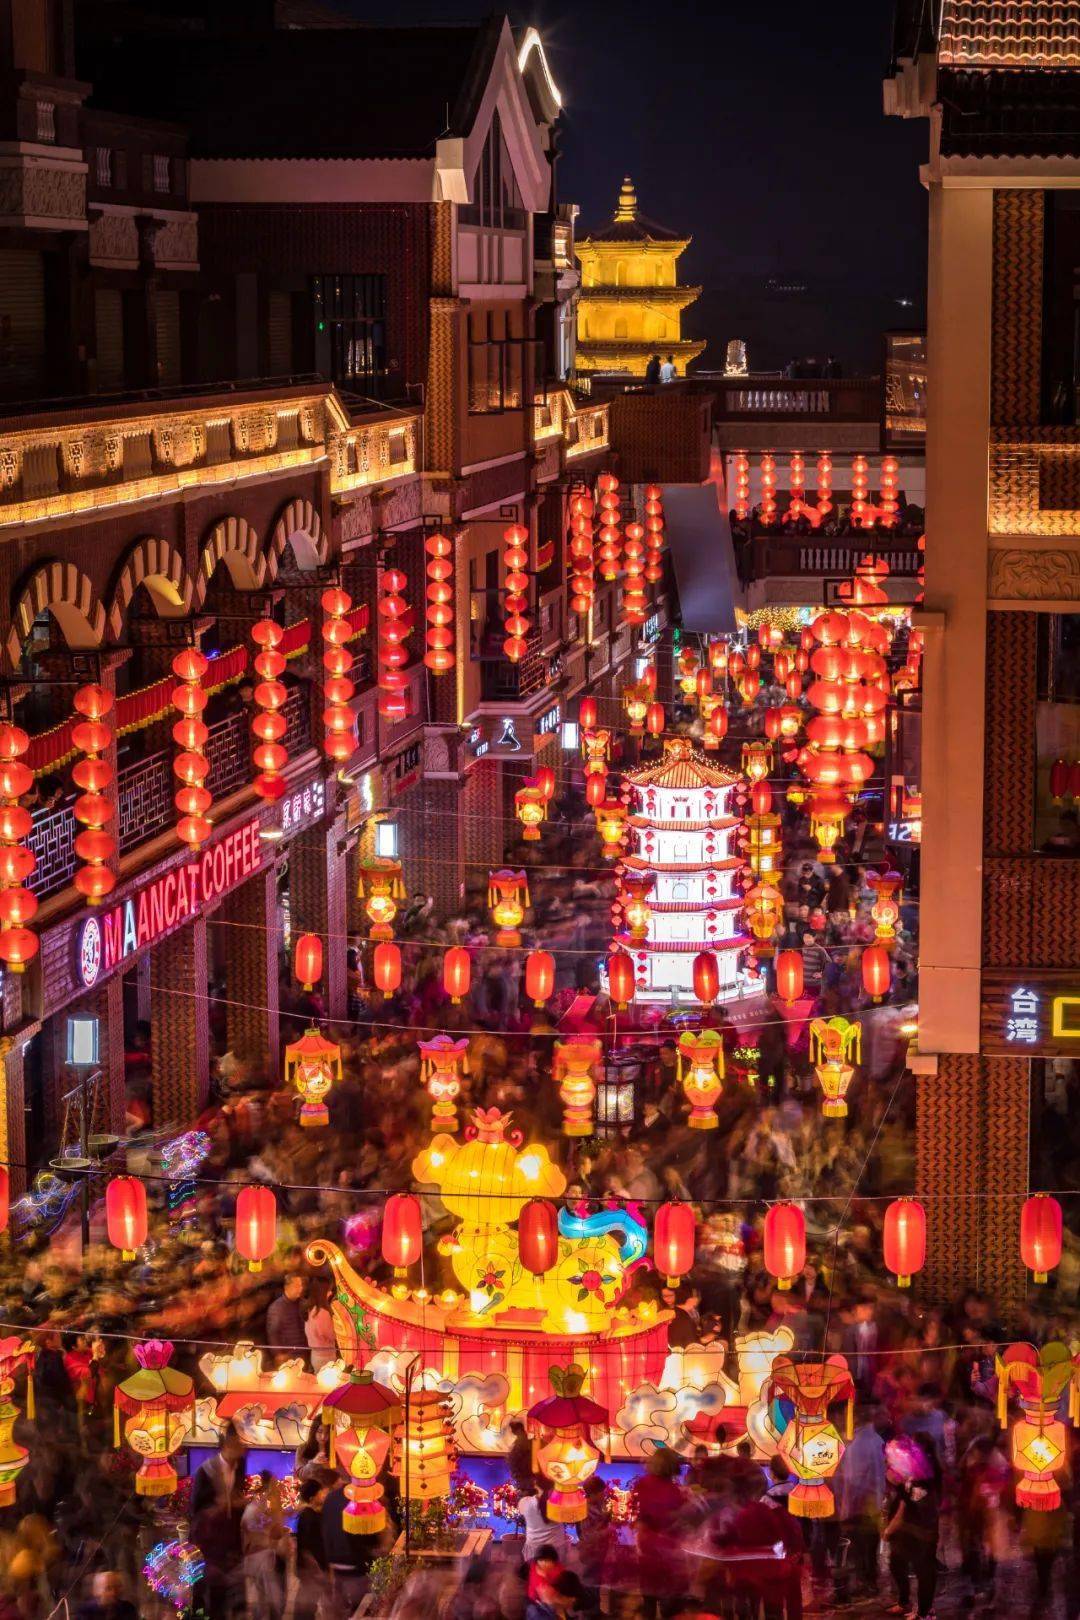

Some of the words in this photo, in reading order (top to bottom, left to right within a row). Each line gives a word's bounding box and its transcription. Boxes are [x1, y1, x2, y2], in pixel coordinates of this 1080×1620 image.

[104, 864, 199, 968] MAANCAT
[202, 820, 260, 900] COFFEE
[1006, 987, 1039, 1042] 台湾
